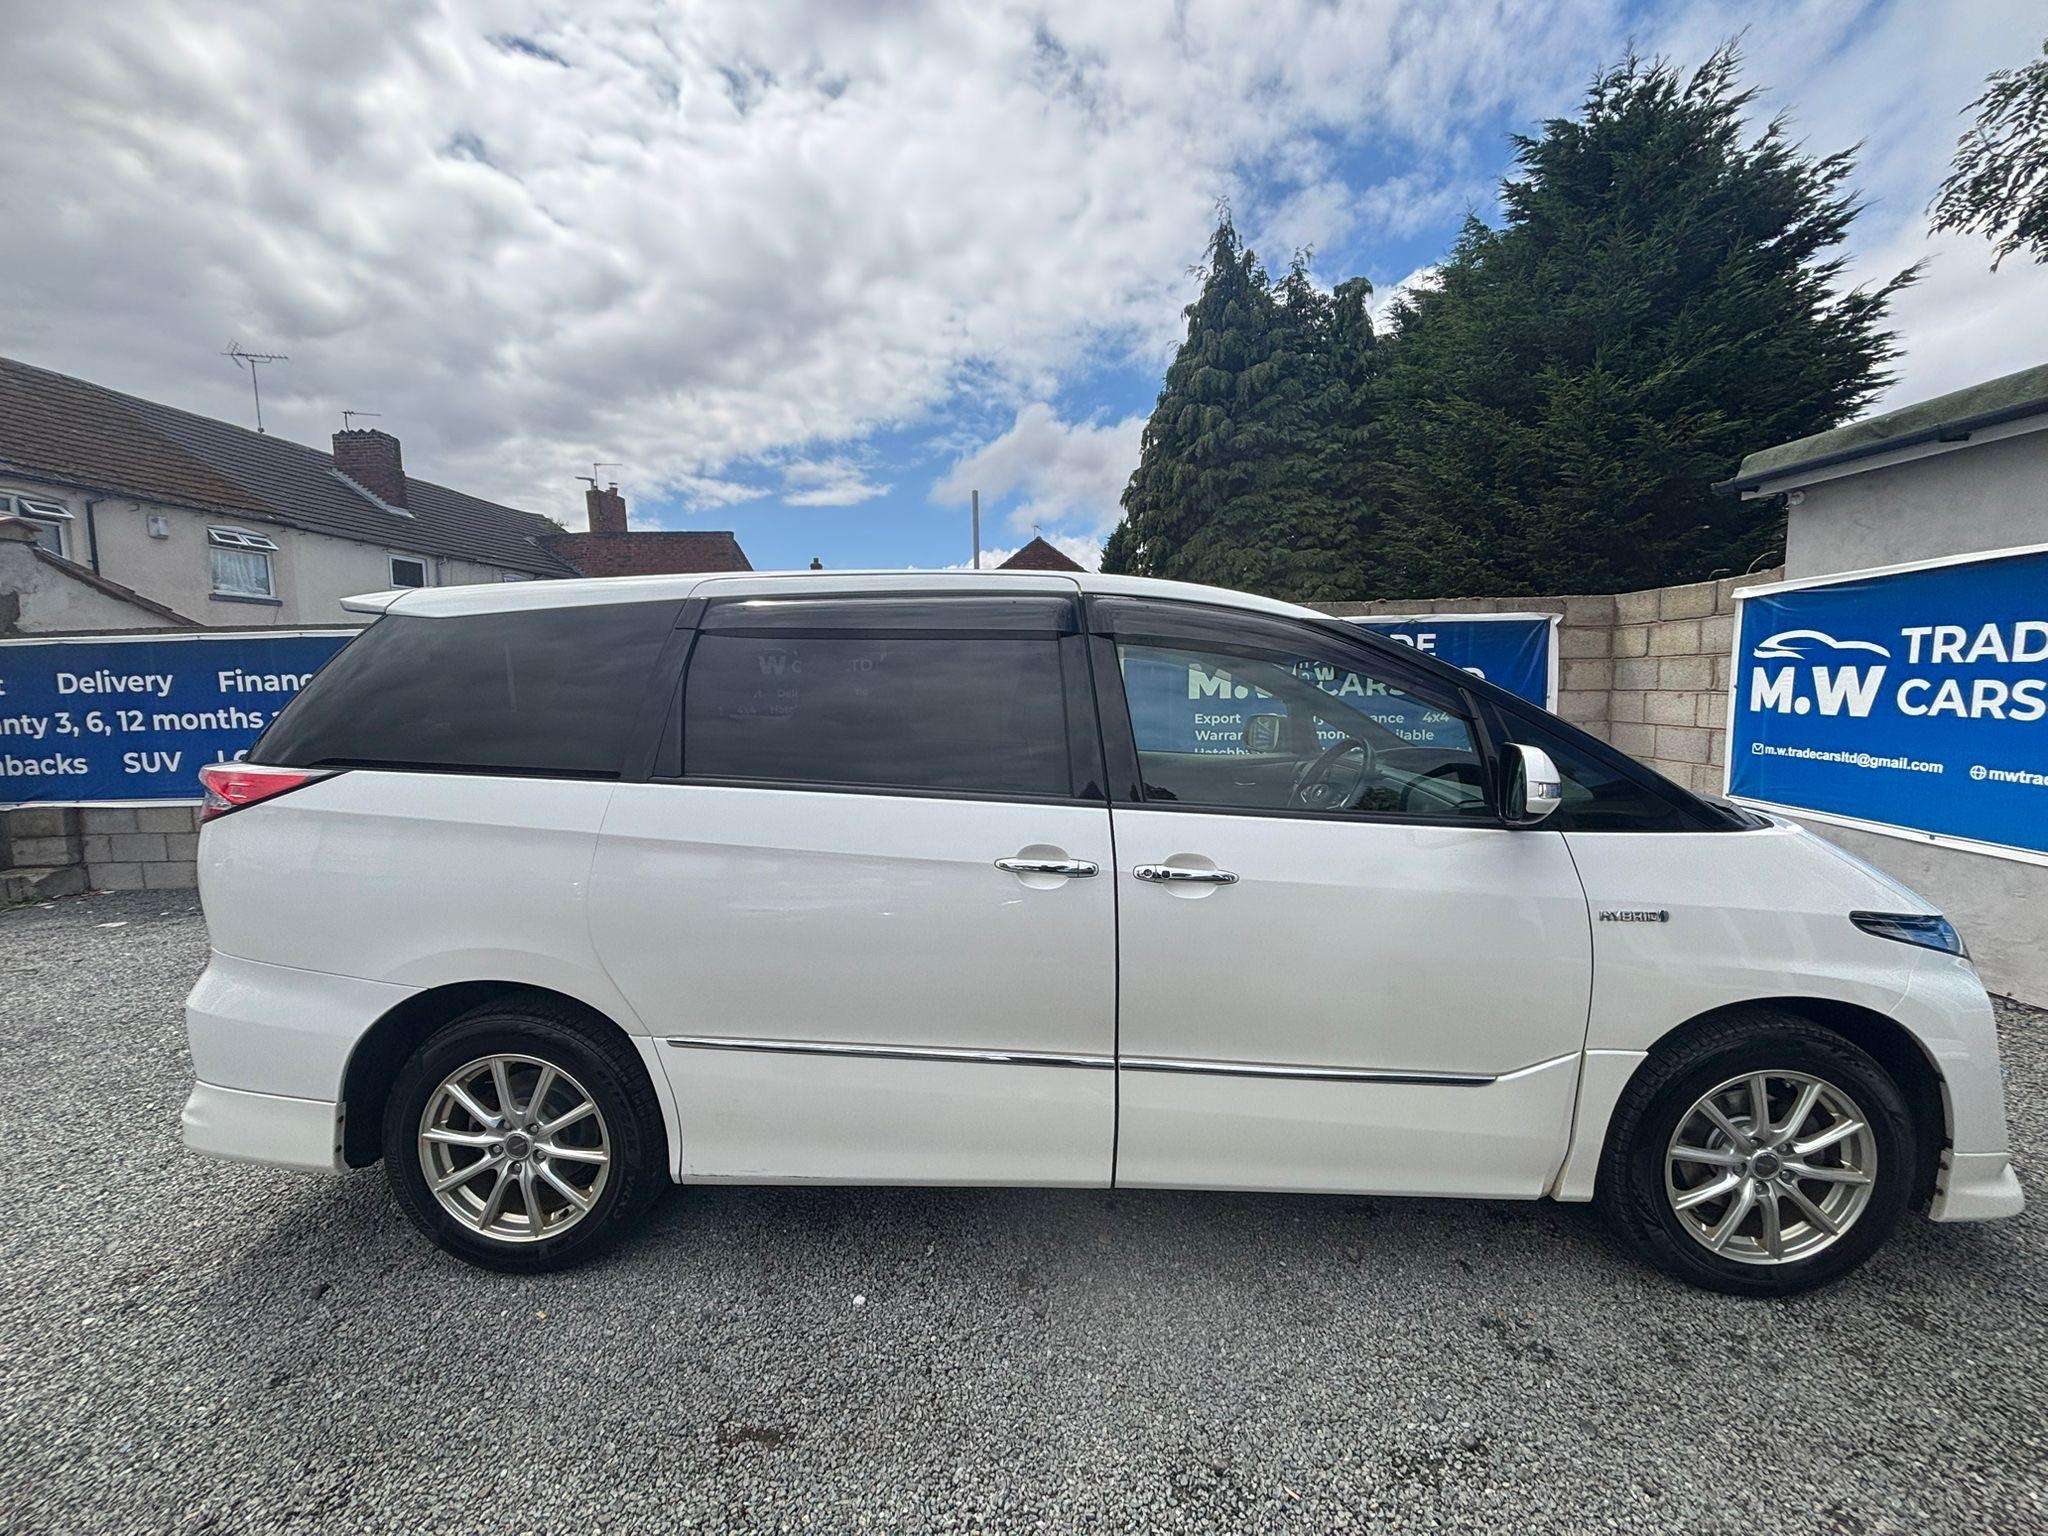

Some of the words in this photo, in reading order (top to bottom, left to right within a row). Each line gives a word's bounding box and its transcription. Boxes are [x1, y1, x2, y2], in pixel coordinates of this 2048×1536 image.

[1901, 620, 2048, 664] TRAD
[56, 669, 174, 697] Delivery
[1750, 664, 1887, 717] M.W
[1896, 678, 2047, 721] CARS
[0, 714, 49, 740] nty
[54, 712, 80, 738] 3,
[85, 711, 112, 737] 6,
[115, 710, 147, 732] 12
[152, 706, 265, 732] months
[1194, 713, 1242, 726] Export
[1422, 711, 1450, 723] 4x4
[0, 752, 89, 777] backs
[123, 751, 183, 774] SUV
[1764, 744, 1944, 774] m.w.tradecarsltd@gmail.com
[1599, 910, 1658, 922] HYBRID
